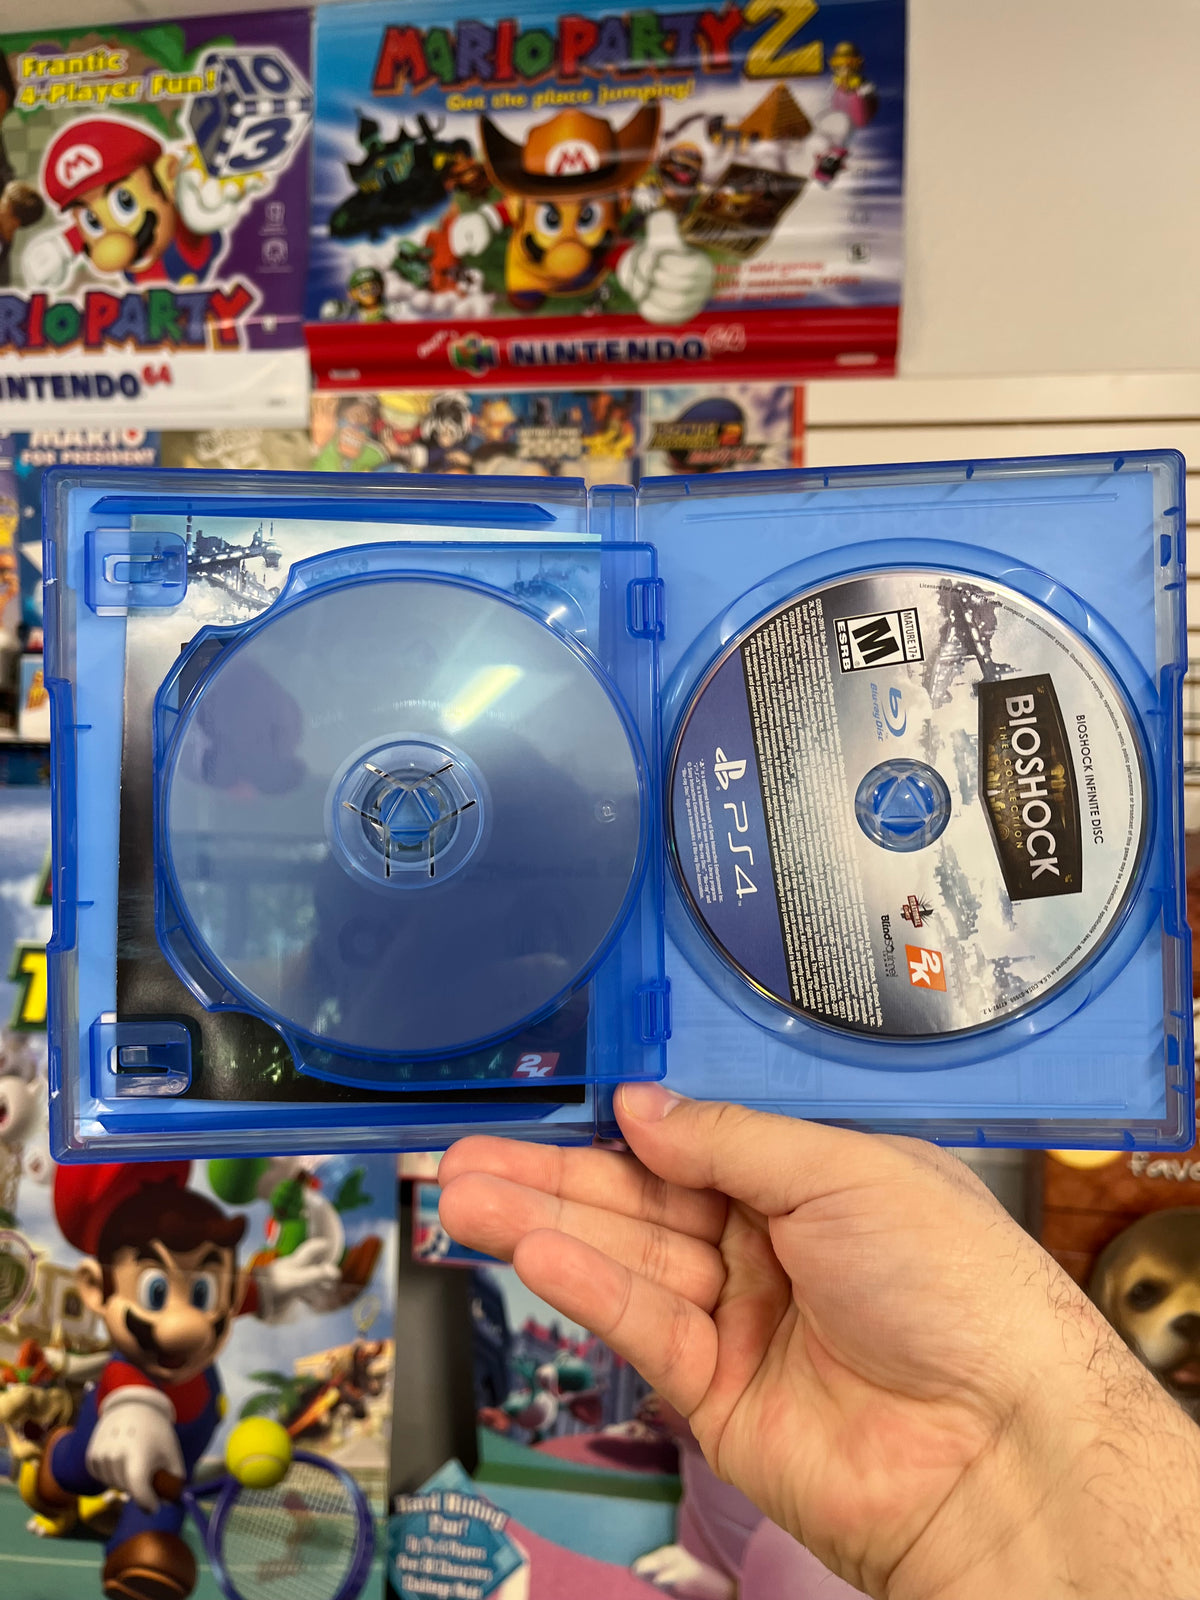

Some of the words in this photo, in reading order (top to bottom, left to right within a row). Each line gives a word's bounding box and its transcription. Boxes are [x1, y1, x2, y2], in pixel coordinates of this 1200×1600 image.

[743, 0, 823, 78] 2
[21, 52, 123, 78] Frantic
[19, 80, 141, 106] 4-Player
[151, 69, 217, 95] Fun!
[447, 93, 485, 110] Get
[491, 92, 525, 107] the
[532, 88, 593, 110] place
[600, 79, 696, 106] jumping!
[508, 337, 704, 365] NINTENDO
[0, 374, 139, 399] NTENDO
[141, 363, 173, 386] 64
[852, 616, 900, 665] M
[902, 611, 918, 644] MATURE
[1025, 616, 1055, 641] entertainment
[836, 621, 852, 671] ESRB
[907, 644, 918, 659] 17+
[748, 685, 757, 711] publishers
[870, 682, 882, 720] Blu-ray
[754, 728, 764, 754] videogame
[875, 720, 884, 742] Disc
[1076, 714, 1094, 772] BIOSHOCK
[998, 725, 1010, 751] THE
[1004, 757, 1024, 850] COLLECTION
[1005, 693, 1060, 881] BIOSHOCK
[1085, 771, 1101, 817] INFINITE
[1125, 764, 1134, 795] performance
[692, 801, 701, 832] Entertainment
[1091, 818, 1104, 845] DISC
[724, 801, 758, 899] PS4
[771, 847, 781, 873] encourage
[1121, 847, 1129, 861] game
[713, 863, 723, 894] Entertainment
[775, 873, 784, 896] engaging
[1105, 884, 1118, 905] violation
[782, 912, 790, 932] conduct
[1088, 909, 1106, 934] applicable
[784, 933, 793, 954] depicted
[1054, 944, 1081, 972] Manufactured
[800, 942, 808, 956] rights
[808, 990, 816, 1009] content
[909, 949, 941, 986] 2K
[516, 1053, 553, 1078] 2K
